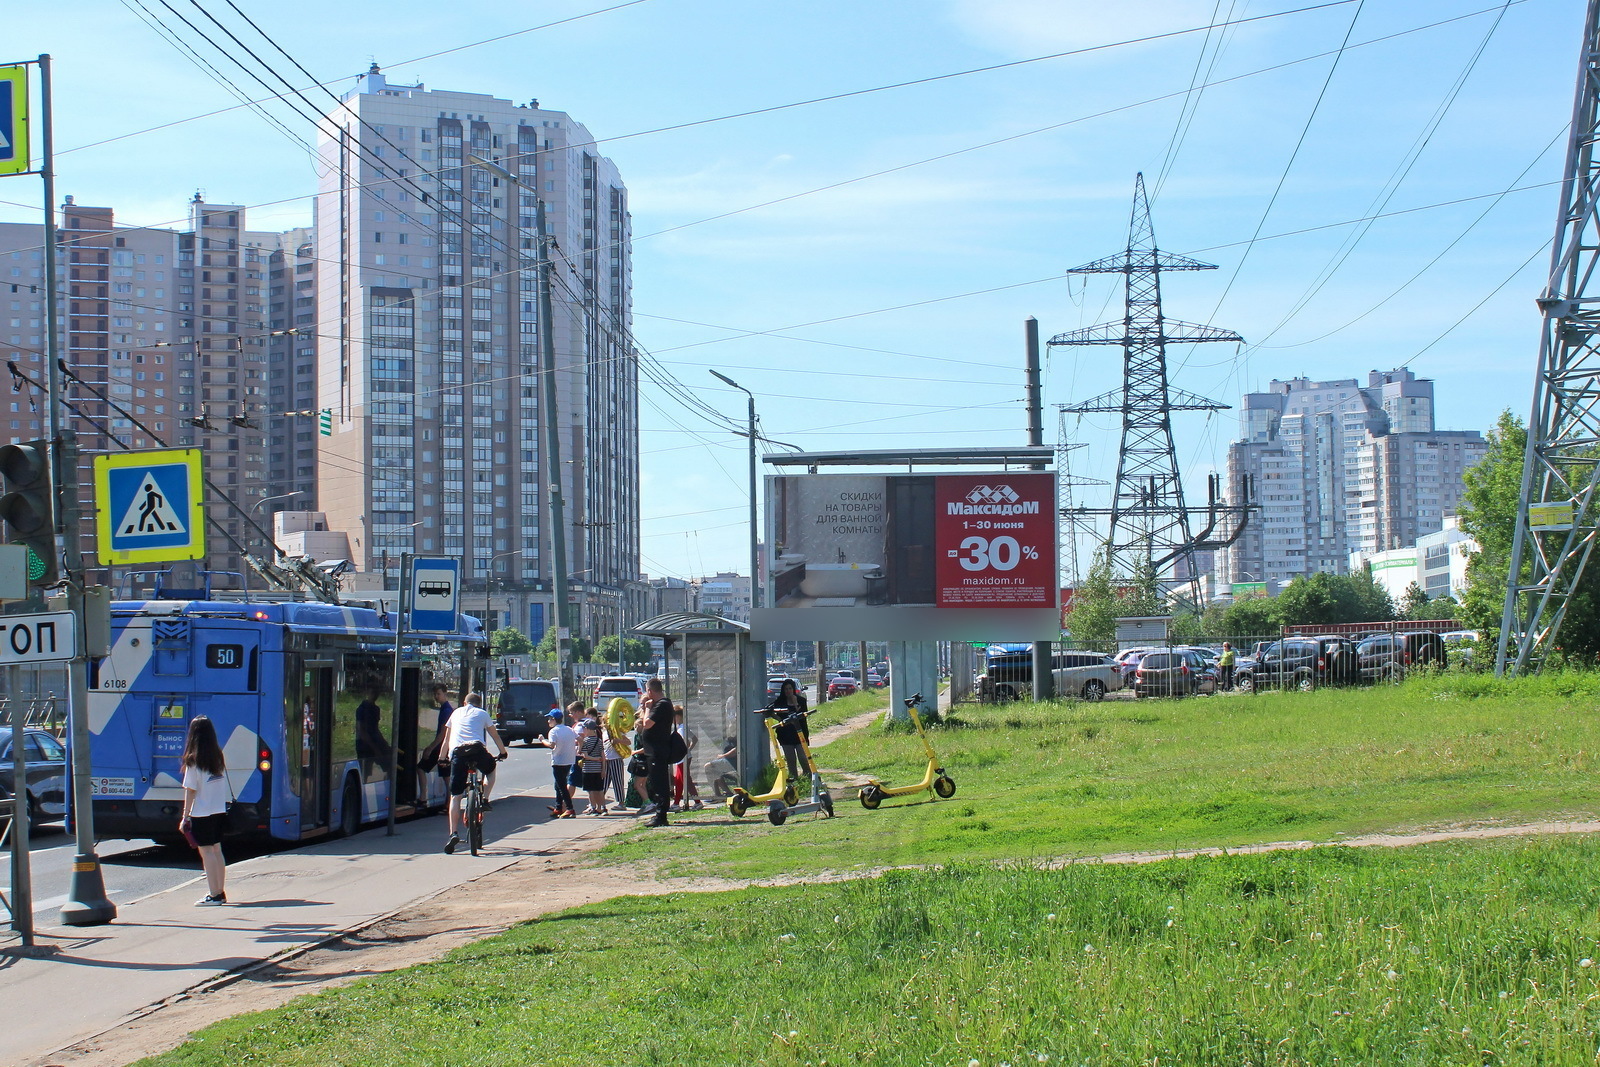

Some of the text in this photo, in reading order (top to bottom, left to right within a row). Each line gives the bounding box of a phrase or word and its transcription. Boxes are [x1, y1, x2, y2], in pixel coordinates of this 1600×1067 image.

[840, 492, 882, 501] СКИДКИ
[825, 503, 882, 512] НА ТОВАРЫ
[816, 513, 882, 524] ДЛЯ ВАННОЙ
[832, 525, 882, 534] КОМНАТЫ
[993, 521, 1025, 529] июня
[963, 576, 1025, 585] maxidom.ru
[0, 621, 56, 655] ОП
[217, 648, 234, 665] 50
[104, 679, 127, 689] 6108
[157, 734, 183, 742] Вынос
